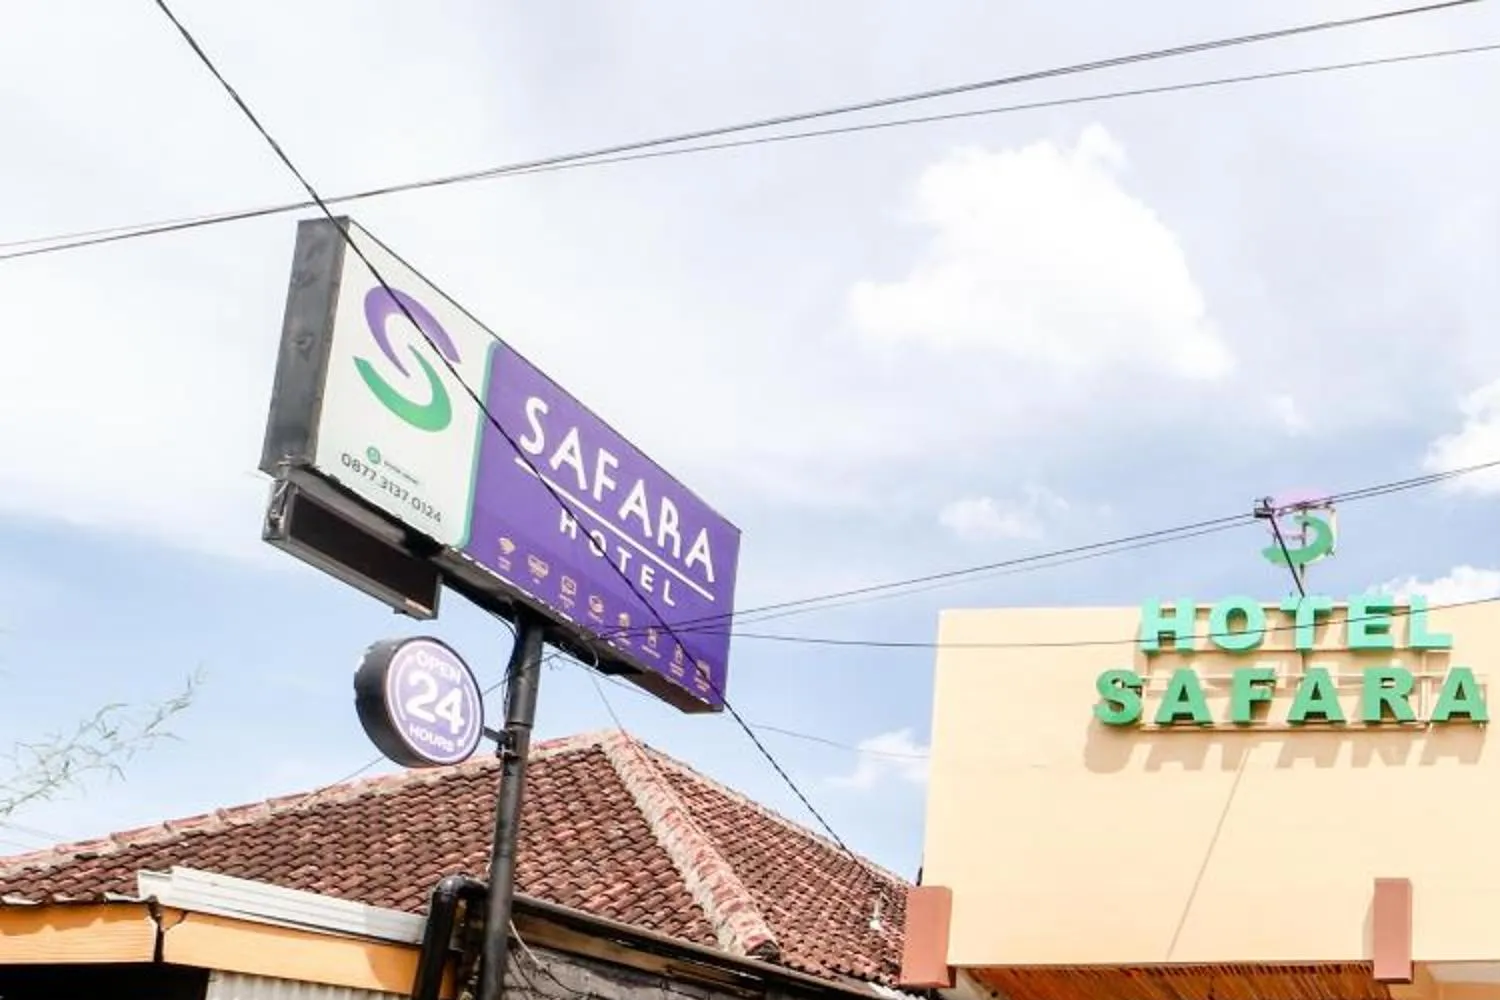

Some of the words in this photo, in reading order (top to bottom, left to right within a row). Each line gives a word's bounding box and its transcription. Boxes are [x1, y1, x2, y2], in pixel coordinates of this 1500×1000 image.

[519, 396, 715, 583] SAFARA
[559, 508, 676, 607] HOTEL
[1137, 594, 1453, 655] HOTEL
[405, 668, 465, 734] 24
[1093, 667, 1489, 727] SAFARA
[408, 722, 455, 753] HOURS
